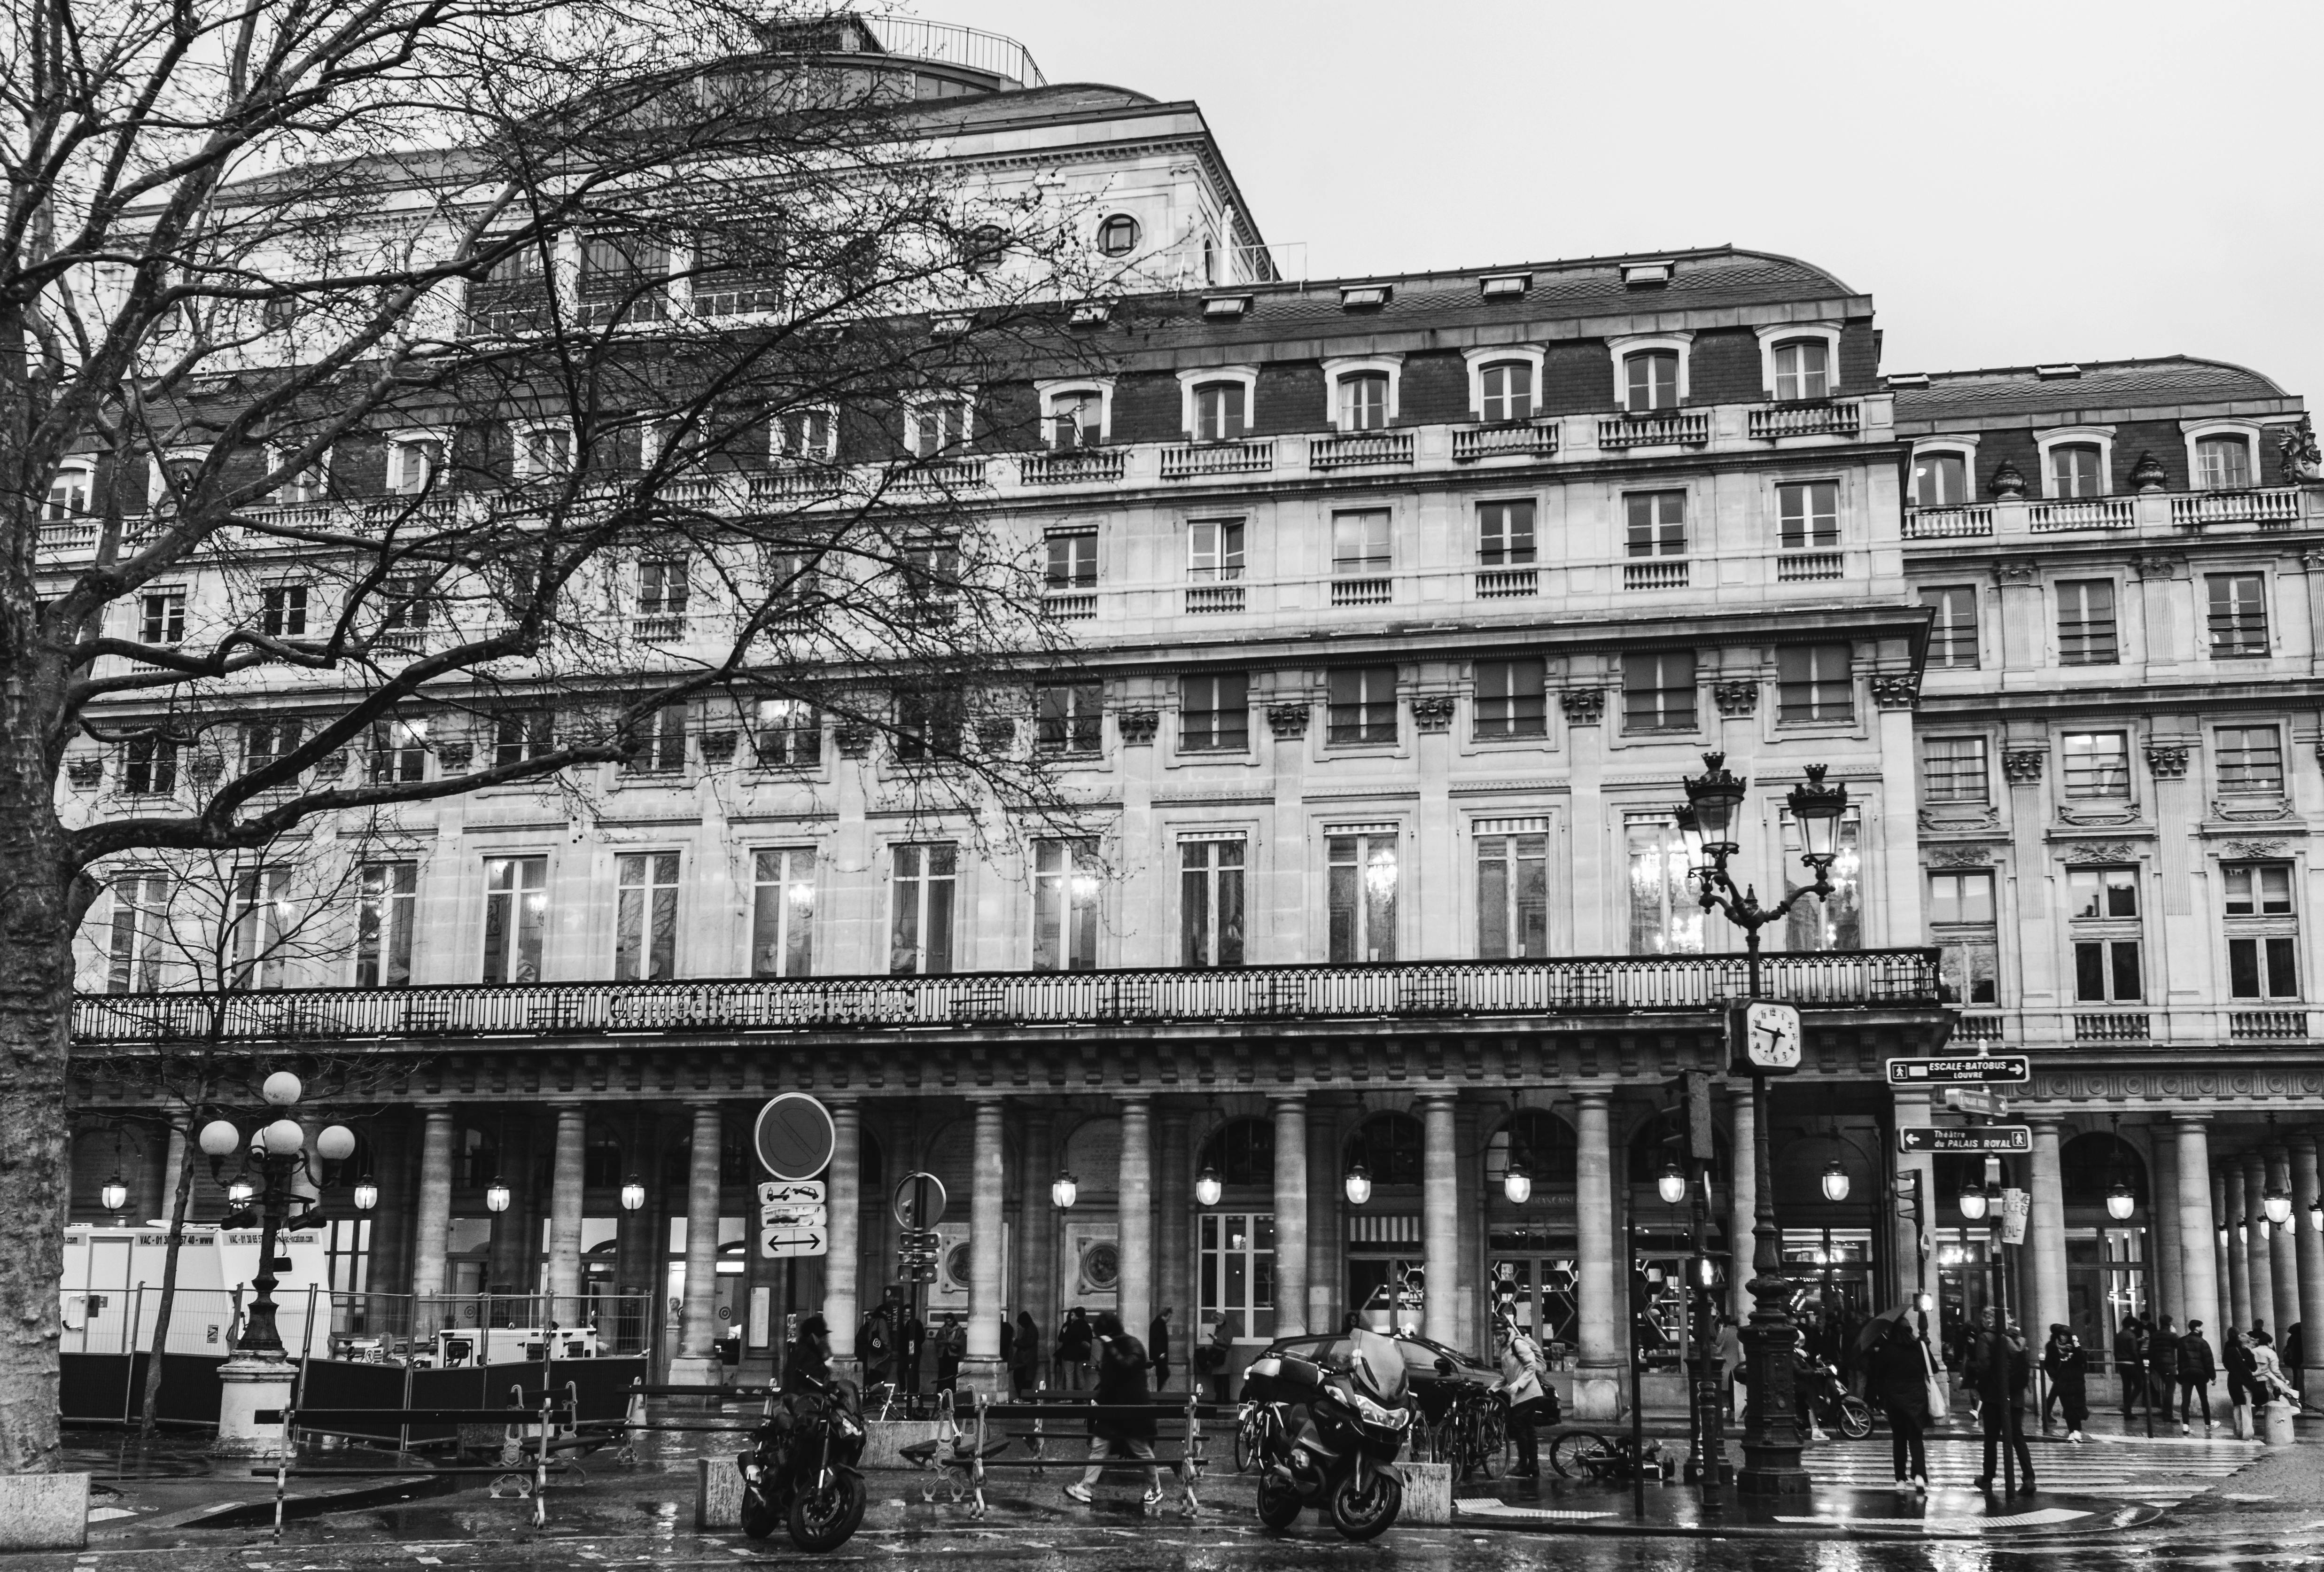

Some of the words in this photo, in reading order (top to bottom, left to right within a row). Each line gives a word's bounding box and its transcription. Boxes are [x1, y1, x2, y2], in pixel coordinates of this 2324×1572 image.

[1929, 1061, 2006, 1071] ESCALE-BATOBUS
[140, 1235, 151, 1245] VAC
[155, 1236, 162, 1245] 01
[188, 1236, 194, 1245] 40
[229, 1235, 238, 1244] VAC
[241, 1235, 246, 1244] 01
[247, 1235, 252, 1244] 30
